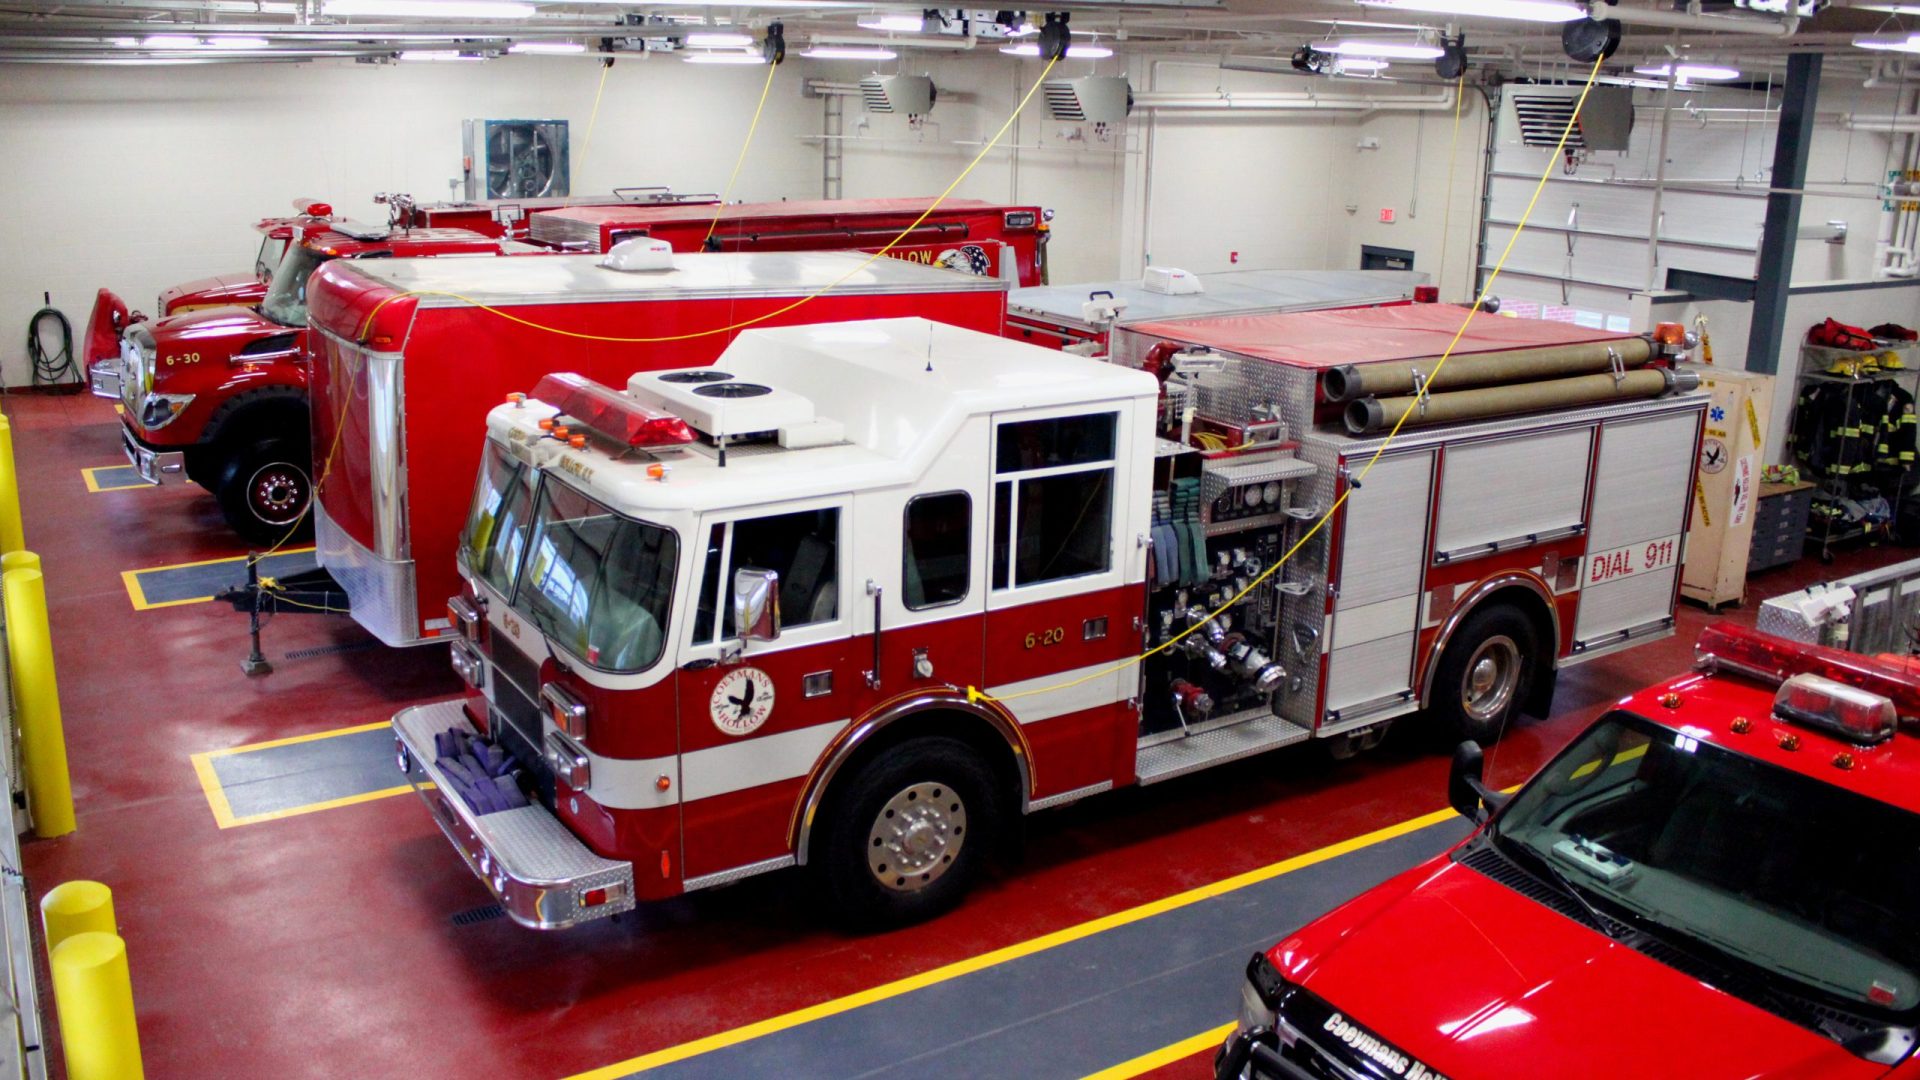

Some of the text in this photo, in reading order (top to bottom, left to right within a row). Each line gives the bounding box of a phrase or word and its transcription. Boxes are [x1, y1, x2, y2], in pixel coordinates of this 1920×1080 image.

[166, 352, 200, 366] 6-30
[1591, 539, 1673, 583] DIAL 911
[1025, 626, 1064, 649] 6-20
[713, 669, 770, 705] COEYMANS
[718, 705, 767, 729] HOLLOW
[1323, 1012, 1410, 1075] Coeymans
